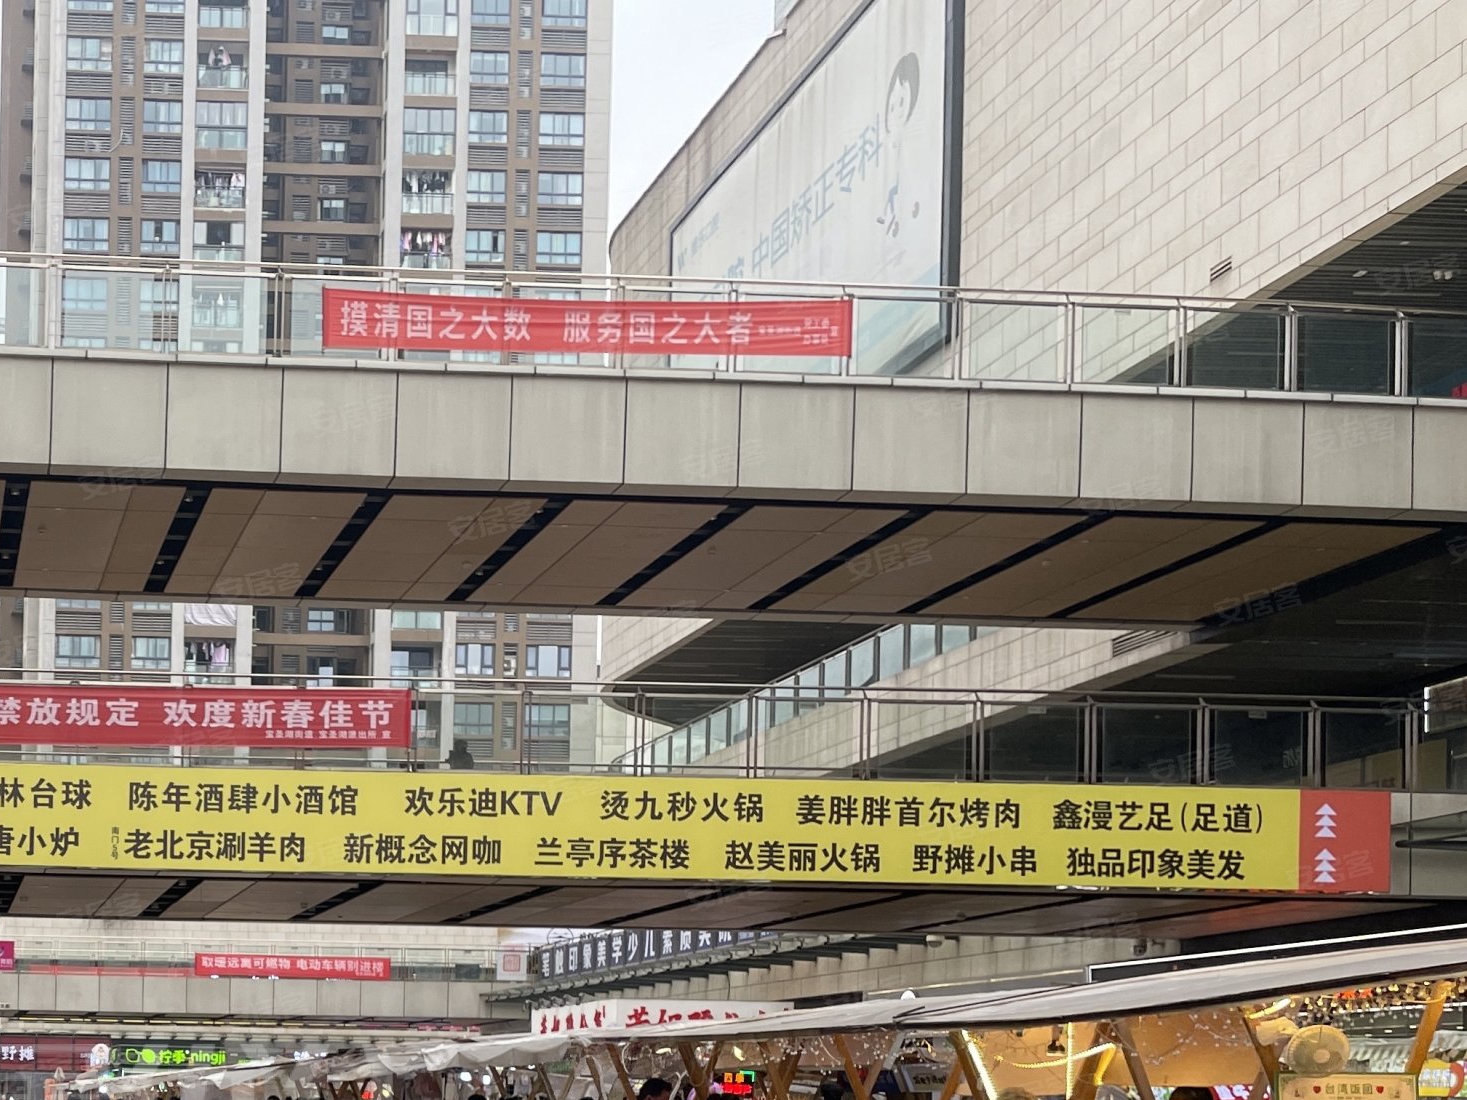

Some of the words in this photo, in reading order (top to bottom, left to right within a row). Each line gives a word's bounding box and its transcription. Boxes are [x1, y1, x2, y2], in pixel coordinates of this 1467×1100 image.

[752, 112, 883, 278] 中国矫正专科
[340, 300, 532, 342] 摸清国之大数
[563, 308, 753, 347] 服务国之大者
[163, 698, 394, 730] 欢度新春佳节
[129, 782, 359, 817] 陈年酒肆小酒馆
[404, 785, 564, 818] 欢乐迪KTV
[600, 790, 764, 823] 烫九秒火锅
[796, 794, 1021, 830] 姜胖胖首尔烤肉
[123, 828, 307, 864] 老北京涮羊肉
[343, 833, 503, 866] 新概念网咖
[534, 837, 691, 870] 兰亭序茶楼
[724, 840, 881, 876] 赵美丽火锅
[912, 842, 1038, 876] 野摊小串
[1067, 847, 1246, 881] 独品印象美发
[201, 956, 291, 971] 取暖远离可燃物
[190, 1050, 226, 1067] ningji
